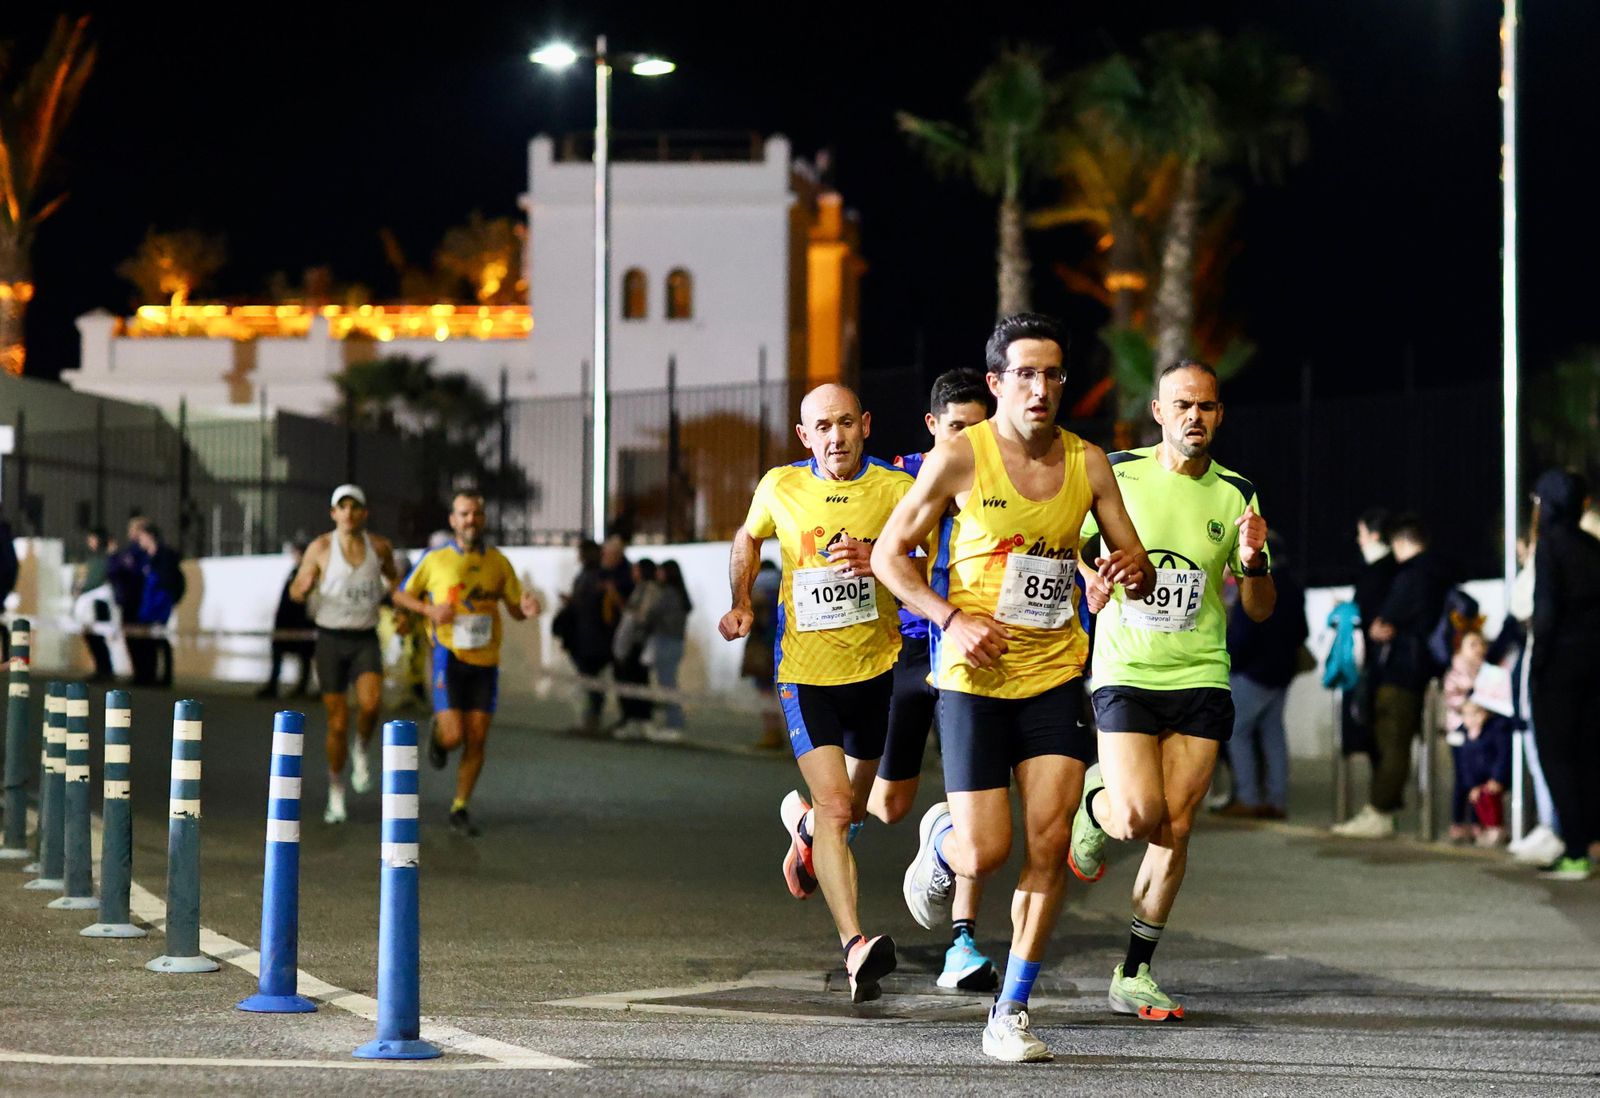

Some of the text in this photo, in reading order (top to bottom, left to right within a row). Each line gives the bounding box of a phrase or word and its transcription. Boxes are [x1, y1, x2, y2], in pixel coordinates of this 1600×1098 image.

[826, 494, 849, 504] vive
[982, 496, 1007, 509] vive
[1176, 573, 1187, 584] M
[811, 583, 858, 604] 1020
[1024, 575, 1064, 601] 856
[821, 612, 846, 620] mayoral
